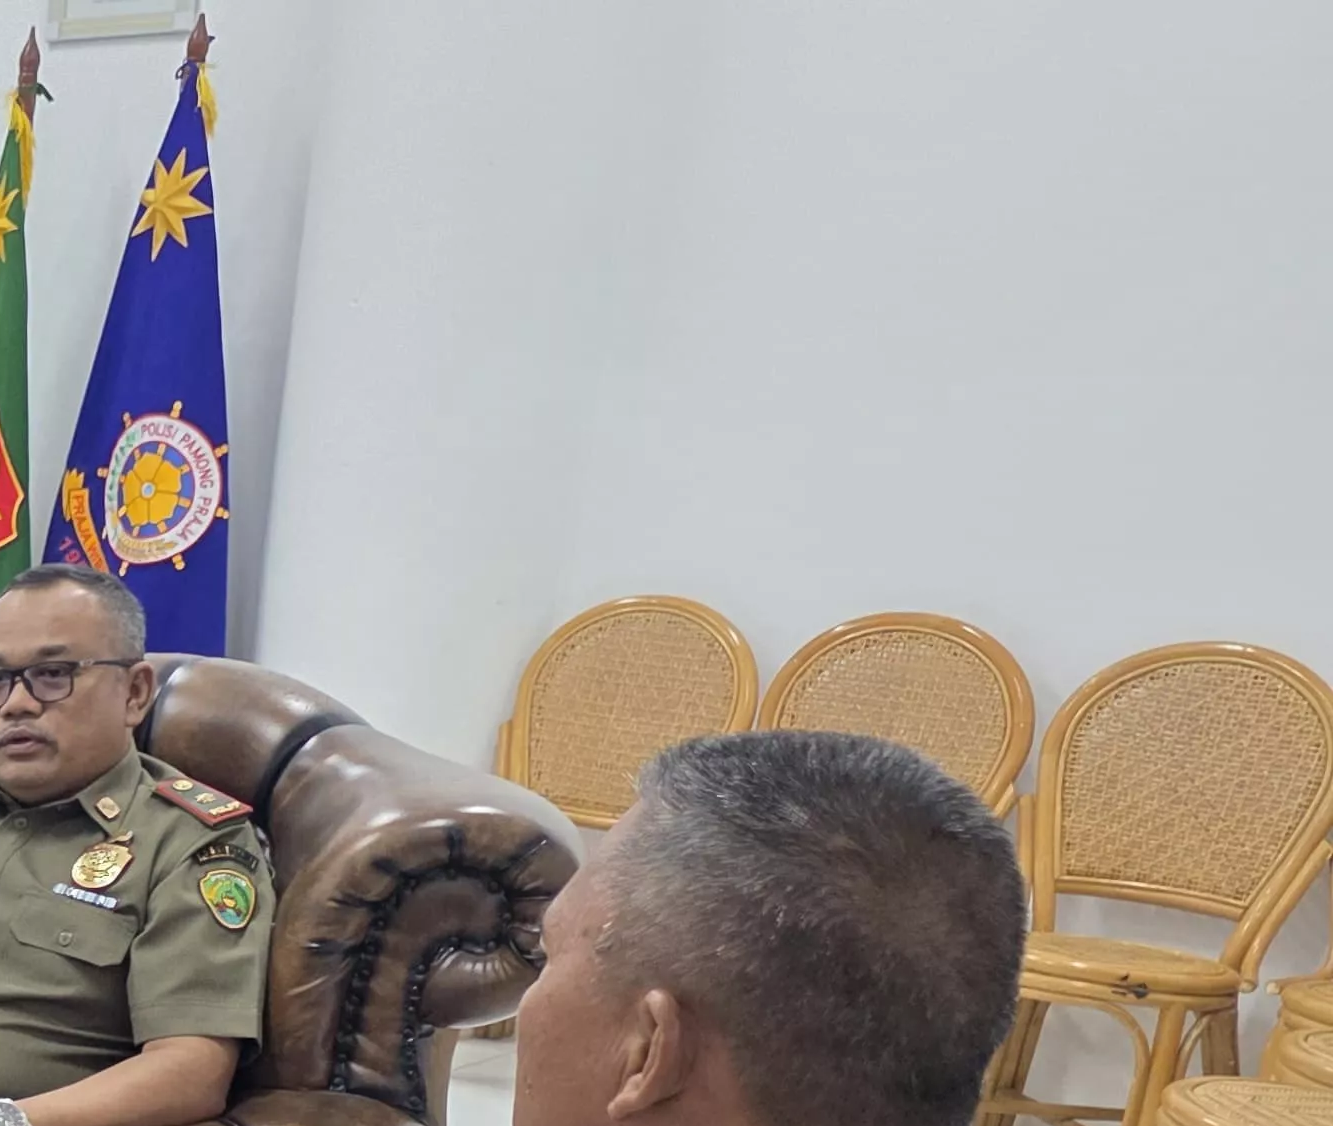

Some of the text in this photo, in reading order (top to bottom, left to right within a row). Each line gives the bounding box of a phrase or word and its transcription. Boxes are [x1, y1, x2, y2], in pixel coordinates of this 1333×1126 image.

[73, 493, 95, 545] PRAJA
[141, 422, 214, 541] POLISI PAMONG PRAJA
